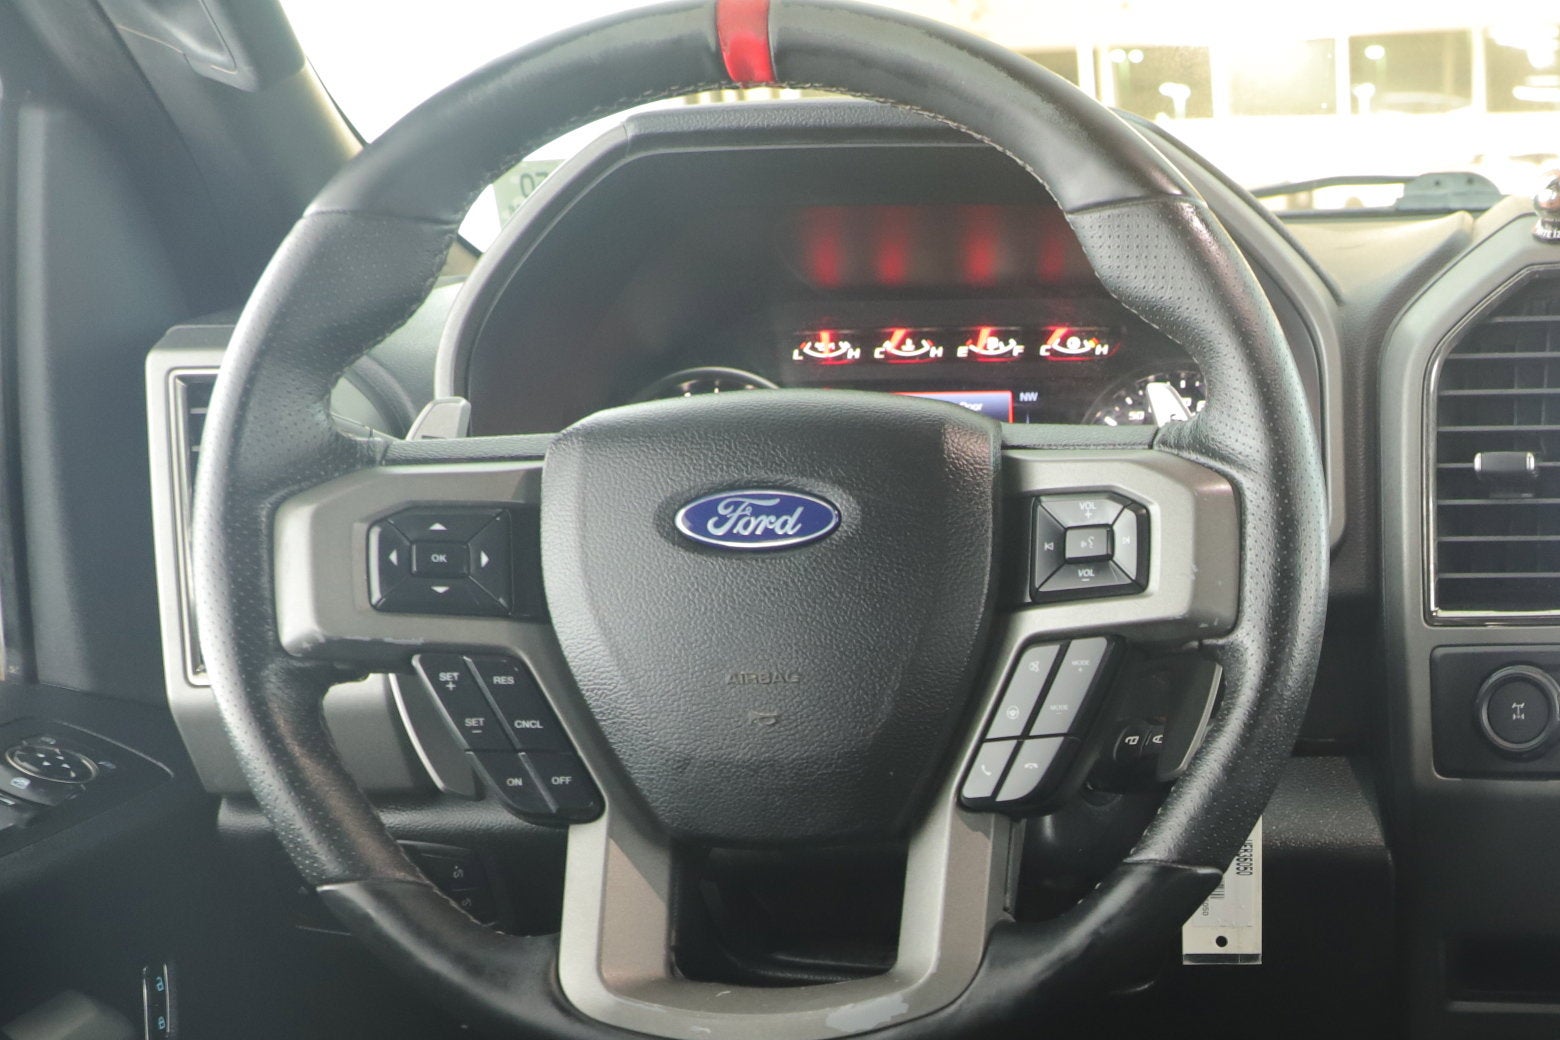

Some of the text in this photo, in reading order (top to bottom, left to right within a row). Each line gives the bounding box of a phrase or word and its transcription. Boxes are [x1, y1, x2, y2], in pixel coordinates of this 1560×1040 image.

[847, 348, 860, 360] H
[874, 348, 885, 359] C
[929, 348, 943, 358] H
[957, 348, 968, 357] E
[1013, 345, 1025, 357] F
[1039, 346, 1051, 357] C
[1095, 344, 1108, 356] H
[792, 349, 803, 361] L
[1020, 392, 1038, 401] NW
[1079, 502, 1096, 510] VOL
[707, 497, 804, 535] Ford
[431, 553, 448, 562] OK
[1078, 568, 1095, 577] VOL
[439, 672, 460, 681] SET
[493, 676, 515, 685] RES
[727, 672, 800, 684] AIRBAG
[464, 718, 485, 726] SET
[514, 720, 543, 729] CNCL
[506, 778, 522, 786] ON
[552, 776, 572, 785] OFF
